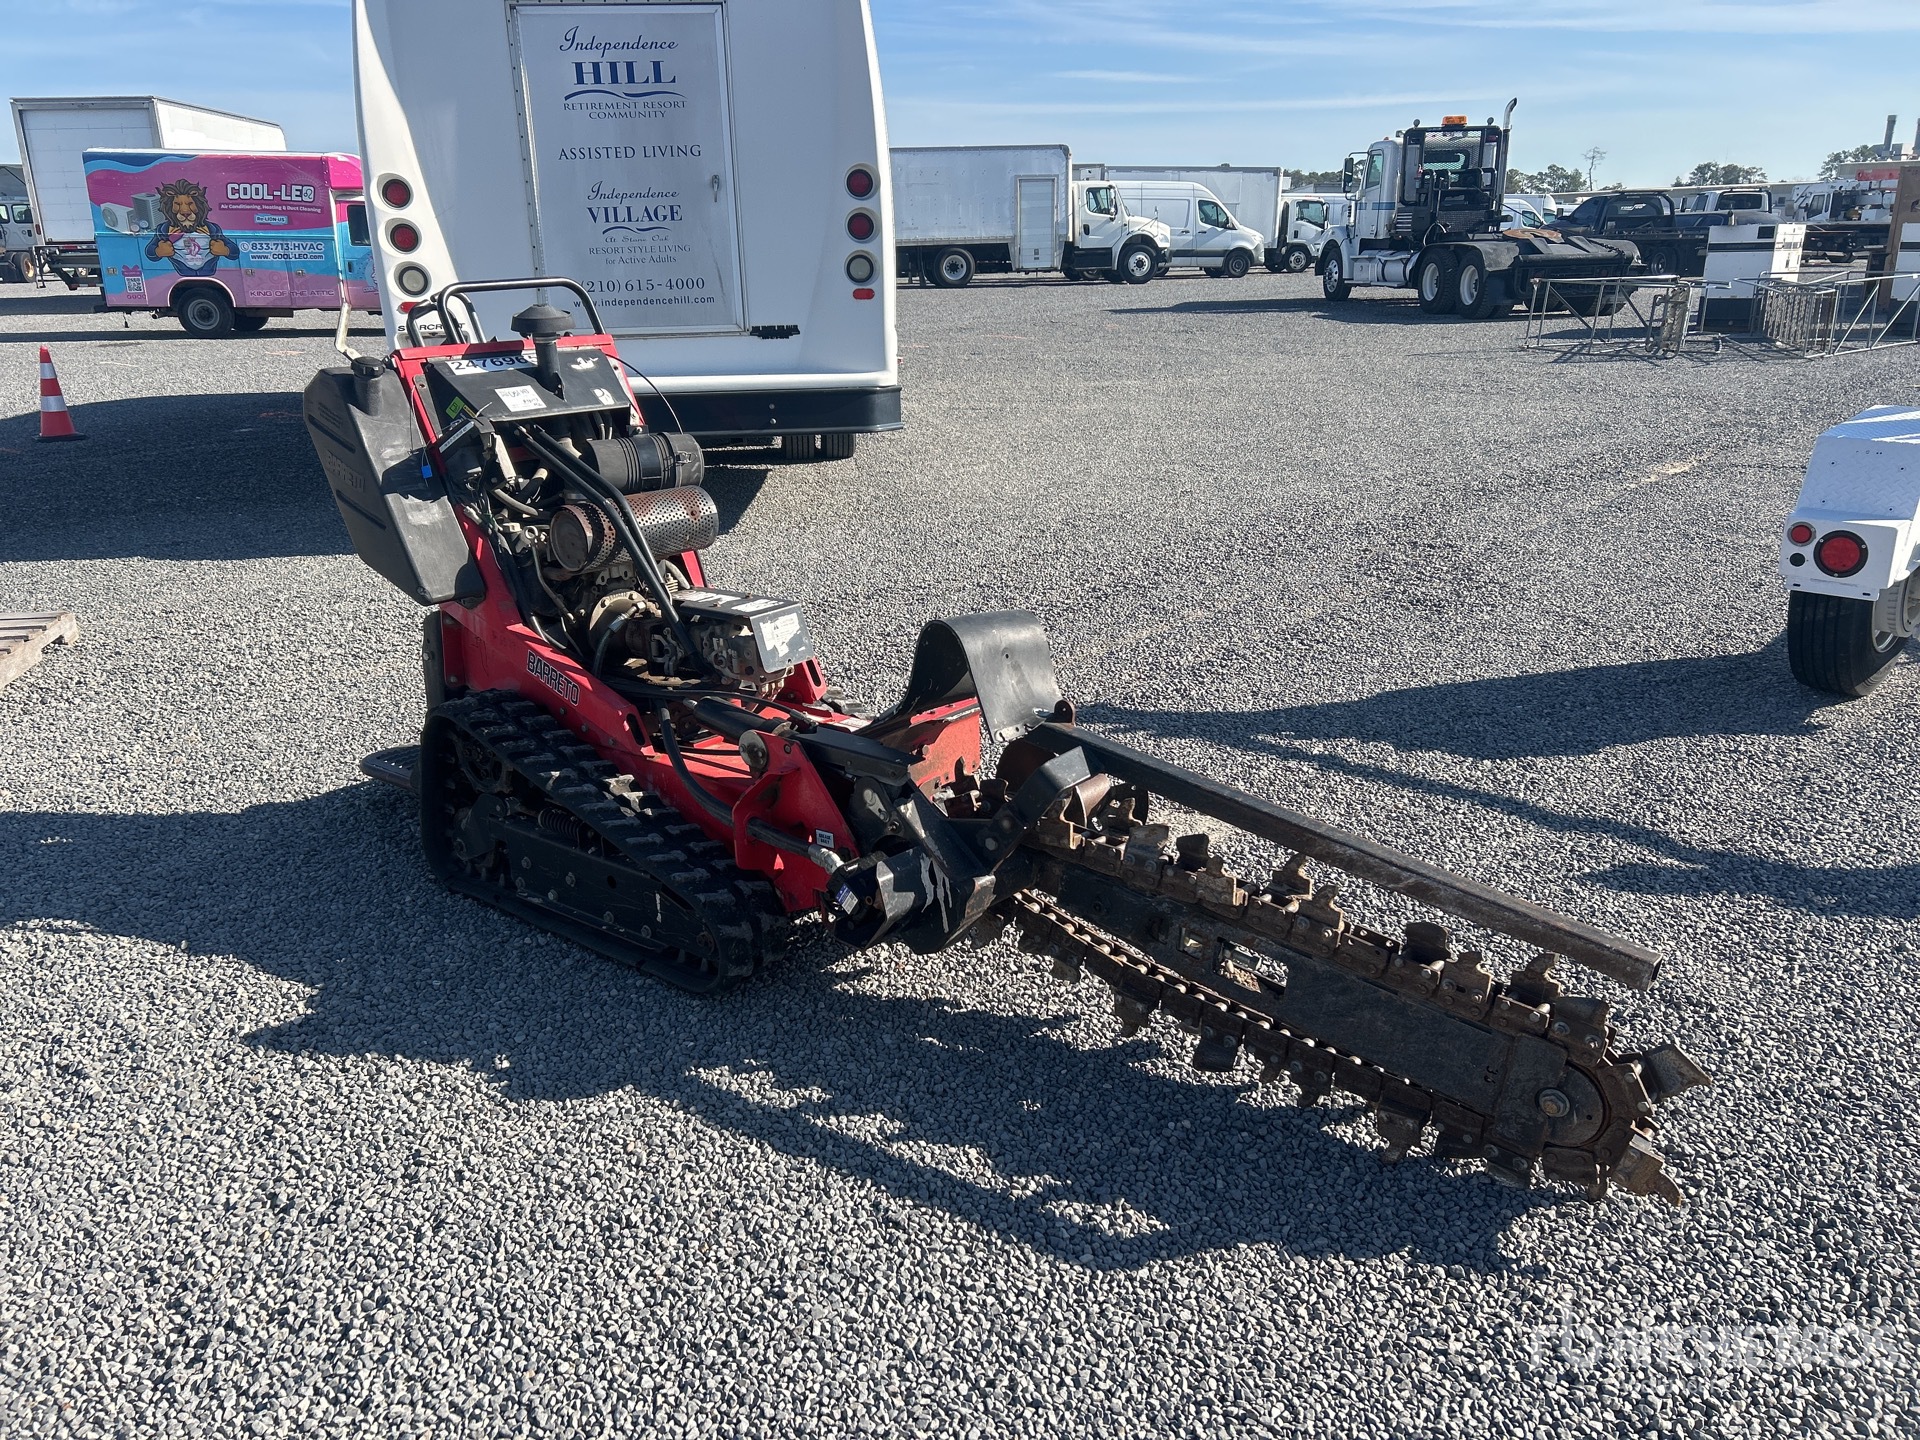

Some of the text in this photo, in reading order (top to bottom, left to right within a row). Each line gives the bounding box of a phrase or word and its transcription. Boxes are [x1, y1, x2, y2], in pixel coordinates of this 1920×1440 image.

[559, 25, 679, 58] Independence
[571, 60, 677, 86] HILL
[563, 100, 688, 111] RETIREMENT RESORT
[588, 110, 667, 120] COMMUNITY
[558, 144, 702, 161] ASSISTED LIVING
[226, 183, 315, 203] COOL-LEO
[587, 180, 680, 205] Independence
[586, 204, 683, 224] VILLAGE
[251, 242, 324, 251] 833.713.HVAC
[605, 235, 618, 243] At
[651, 234, 670, 242] Oak
[588, 244, 691, 255] RESORT STYLE LIVING
[618, 256, 646, 265] Active
[649, 254, 677, 263] Adults
[526, 649, 580, 707] BARRETO
